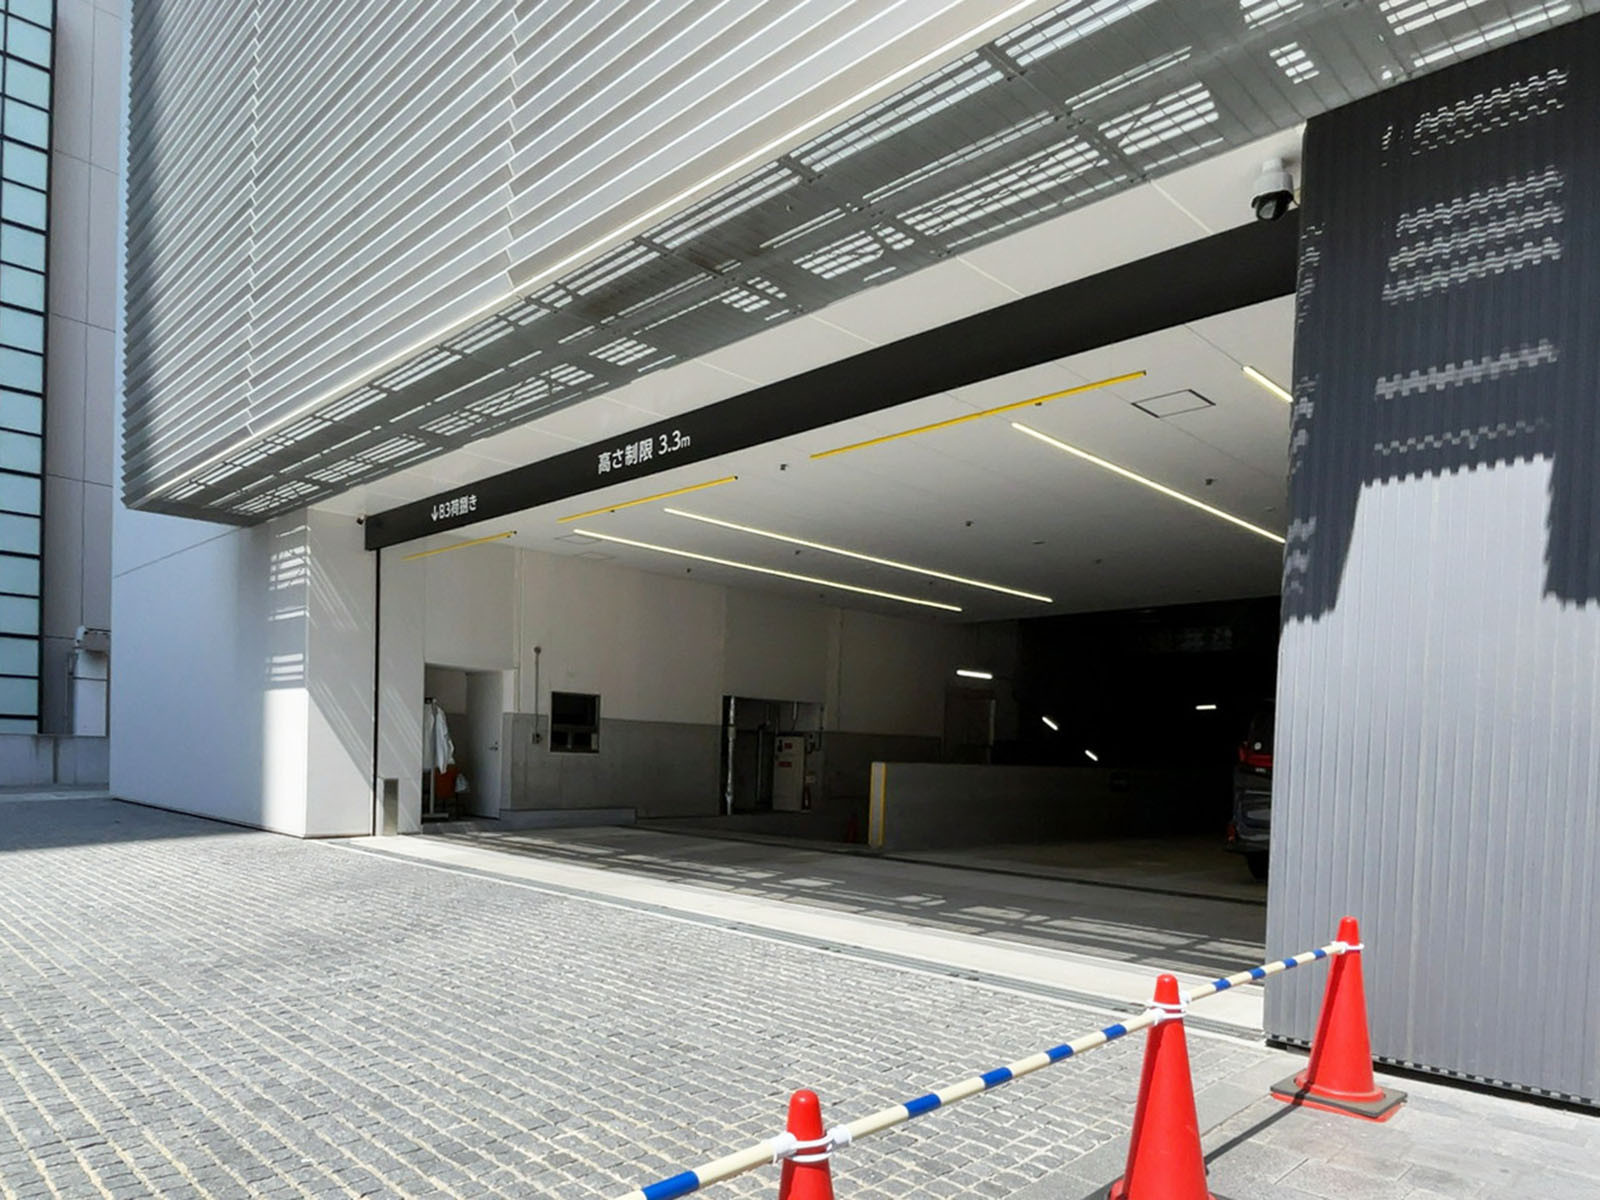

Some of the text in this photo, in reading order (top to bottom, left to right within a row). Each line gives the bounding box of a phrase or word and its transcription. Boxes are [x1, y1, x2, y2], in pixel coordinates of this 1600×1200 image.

[597, 430, 691, 475] 高さ制限 3.3m
